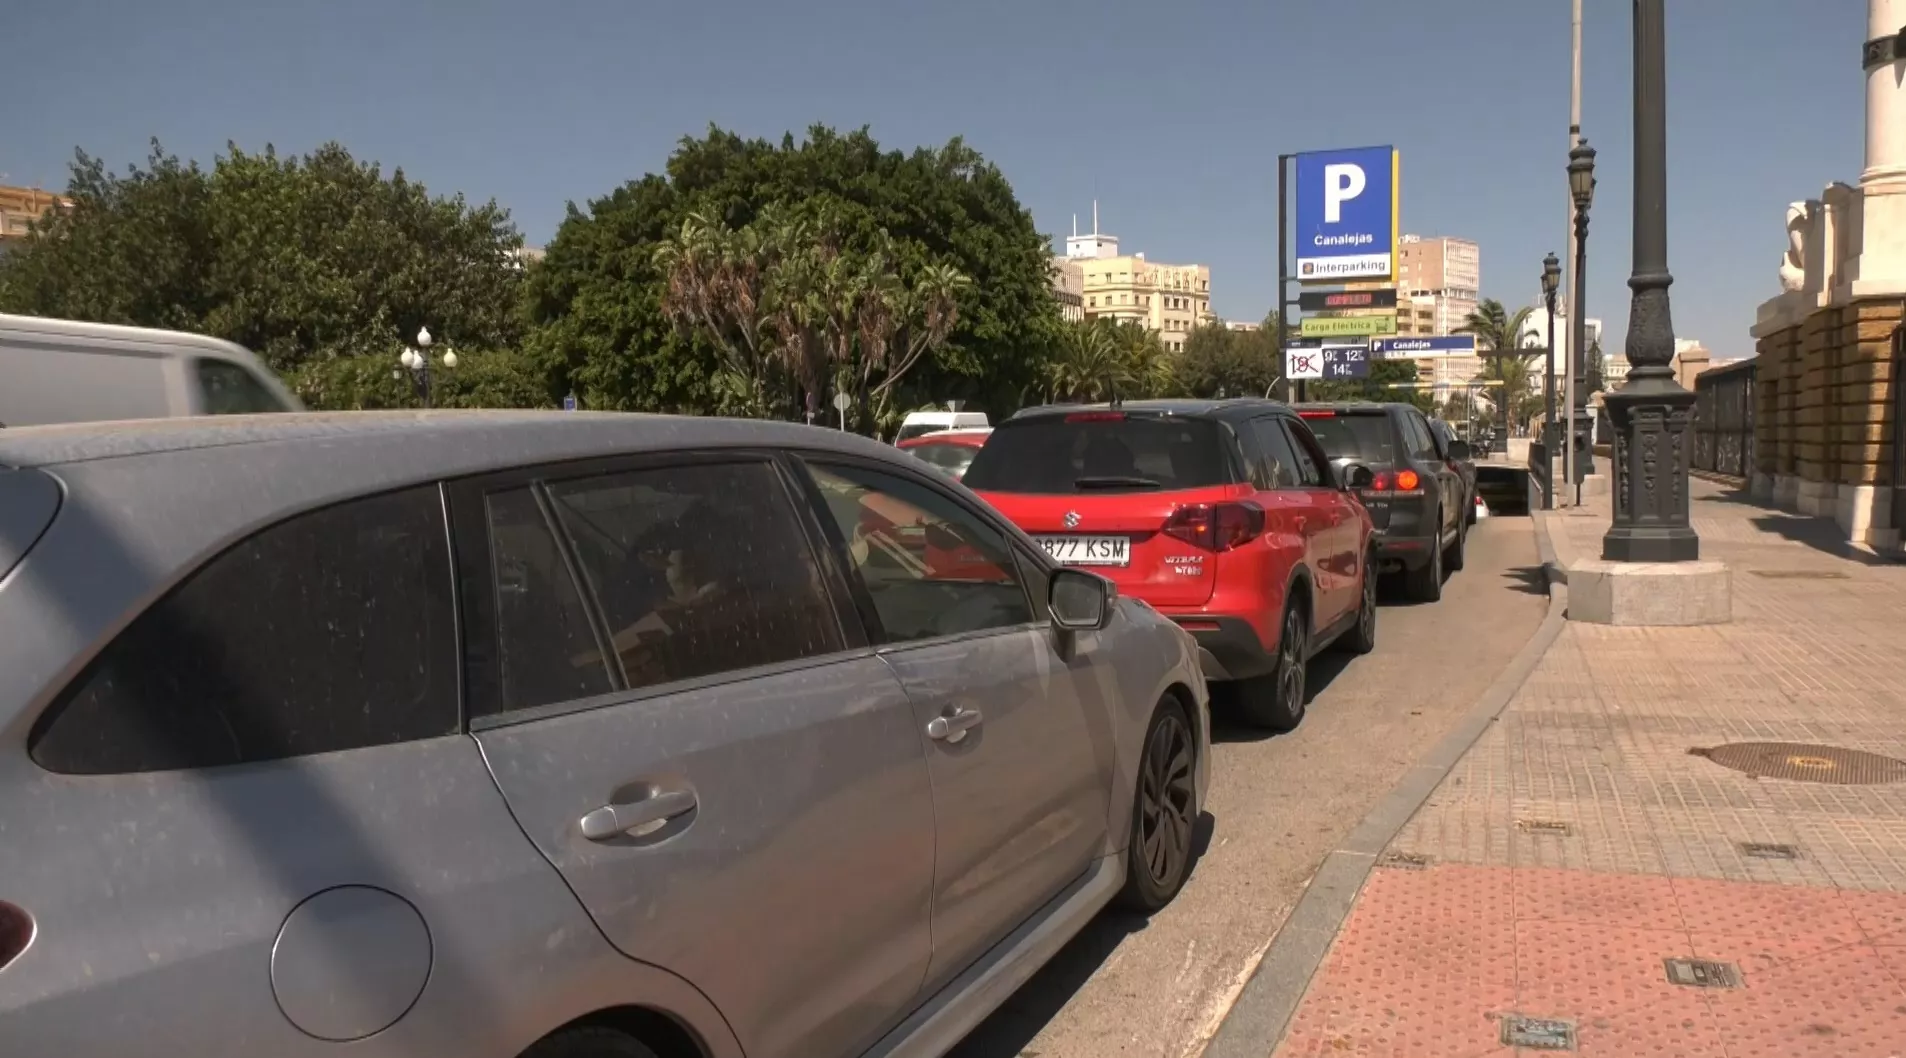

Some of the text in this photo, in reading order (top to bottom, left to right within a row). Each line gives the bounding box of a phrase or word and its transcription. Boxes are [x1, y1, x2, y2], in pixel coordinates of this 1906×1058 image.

[1324, 163, 1366, 223] P
[1314, 232, 1373, 246] Canalejas
[1316, 260, 1385, 274] Interparking
[1304, 323, 1330, 332] Carga
[1393, 340, 1431, 350] Canalejas
[1086, 539, 1124, 558] KSM
